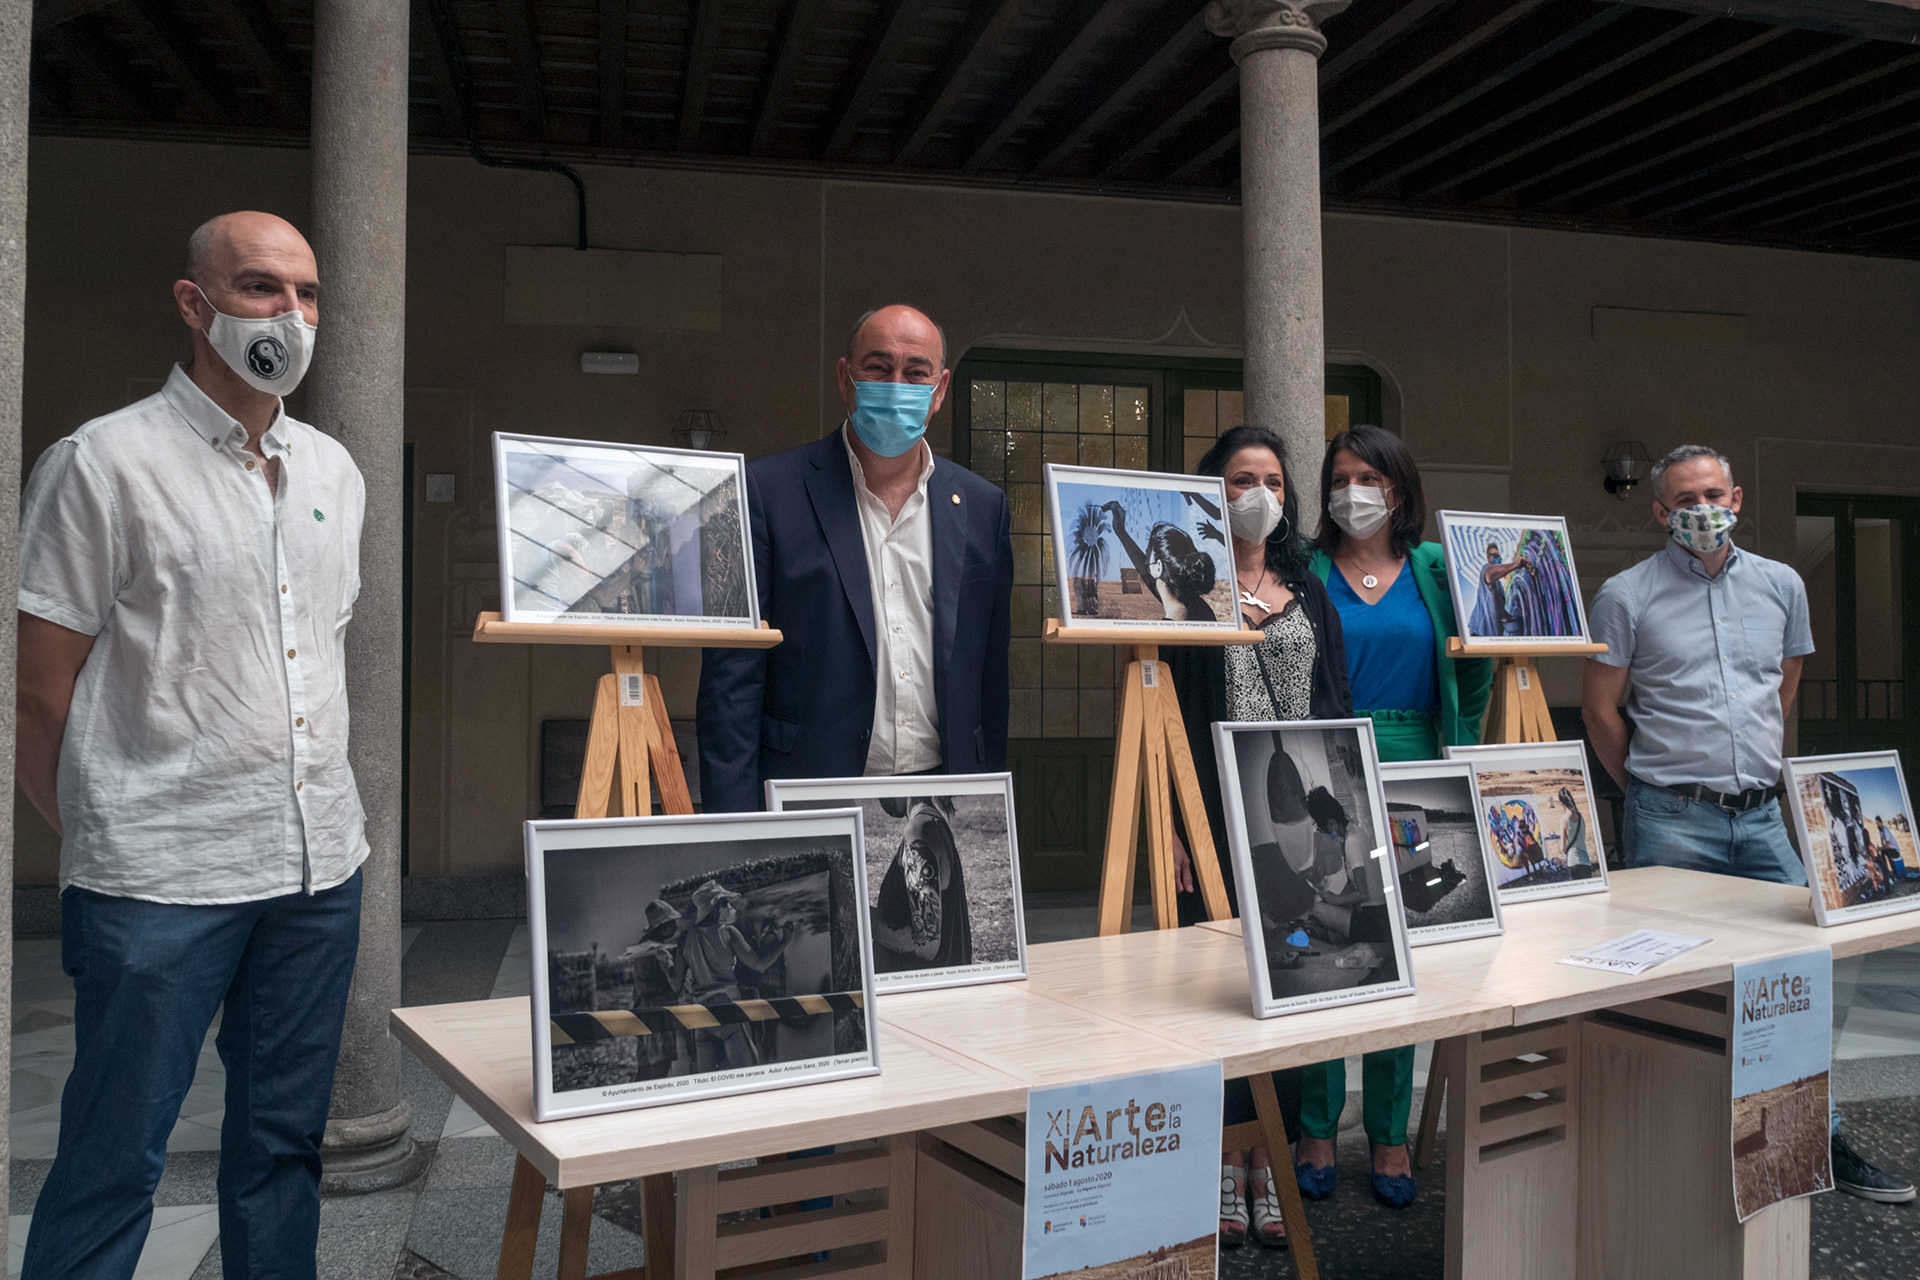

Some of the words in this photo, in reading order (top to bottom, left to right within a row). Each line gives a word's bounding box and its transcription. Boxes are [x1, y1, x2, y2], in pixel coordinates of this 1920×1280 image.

[1743, 979, 1755, 1000] XI
[1755, 972, 1802, 1005] Arte
[1804, 982, 1810, 995] la
[1742, 994, 1810, 1024] Naturaleza
[803, 1062, 817, 1070] Sanz,
[833, 1058, 849, 1066] (Tercer
[851, 1055, 869, 1063] premio)
[608, 1086, 644, 1096] Ayuntamiento
[654, 1082, 675, 1090] Espirdo,
[676, 1079, 689, 1087] 2020
[1170, 1103, 1181, 1112] en
[1046, 1109, 1070, 1139] XI
[1072, 1098, 1166, 1146] Arte
[1169, 1112, 1181, 1129] la
[1045, 1130, 1180, 1174] Naturaleza
[1044, 1180, 1068, 1191] sábado
[1073, 1176, 1095, 1186] agosto
[1095, 1171, 1112, 1181] 2020
